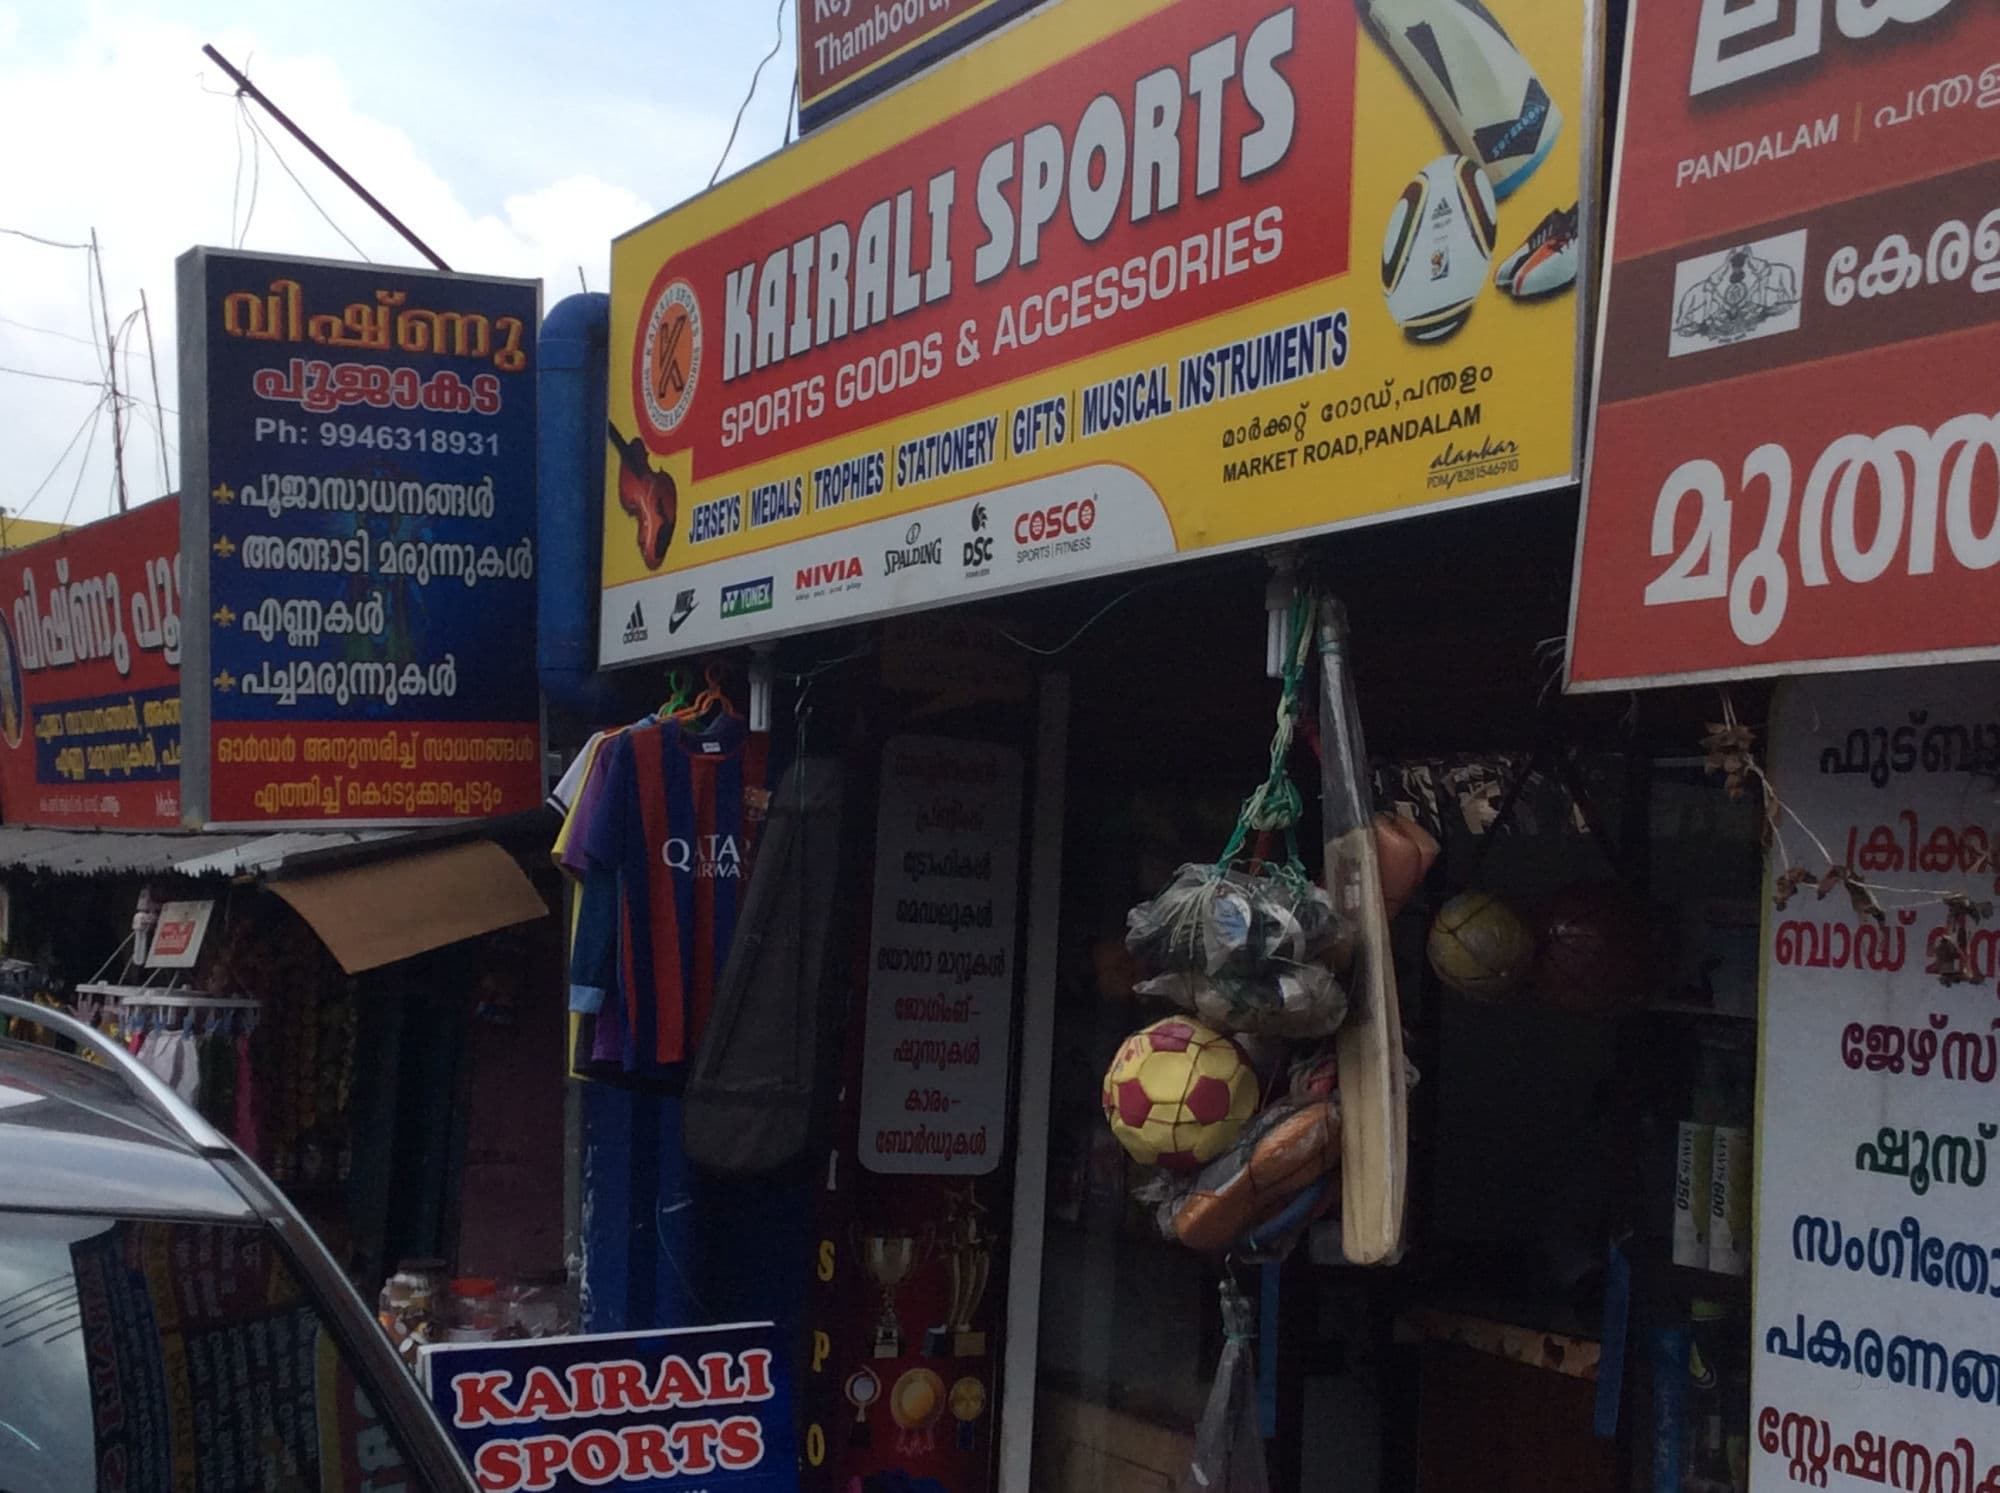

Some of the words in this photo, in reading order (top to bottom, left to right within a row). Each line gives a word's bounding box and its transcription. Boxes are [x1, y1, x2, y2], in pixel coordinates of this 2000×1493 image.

[1675, 113, 1839, 189] PANDALAM
[722, 167, 956, 383] KAIRALI
[975, 6, 1296, 285] SPORTS
[720, 374, 826, 449] SPORTS
[834, 331, 944, 409] GOODS
[956, 318, 981, 368] &
[992, 205, 1284, 357] ACCESSORIES
[253, 357, 501, 414] പൂജാകട
[254, 417, 308, 446] Ph:
[320, 421, 500, 457] 9946318931
[688, 494, 743, 545] JERSEYS
[750, 475, 803, 528] MEDALS
[813, 450, 885, 510] TROPHIES
[896, 415, 999, 488] STATIONERY
[1012, 397, 1067, 456] GIFTS
[1081, 366, 1173, 437] MUSICAL
[1178, 310, 1349, 410] INSTRUMENTS
[1222, 448, 1299, 484] MARKET
[1429, 435, 1520, 471] alankar
[1013, 498, 1096, 545] COSCO
[241, 528, 371, 575] അങ്ങാടി
[378, 537, 534, 588] മരുന്നുകൾ
[795, 556, 864, 591] NIVIA
[883, 537, 943, 578] SPALDING
[962, 535, 995, 568] DSC
[241, 591, 386, 648] എണ്ണകൾ
[673, 588, 697, 615] NIKE
[739, 583, 772, 611] YONEX
[622, 626, 649, 645] adidas
[241, 653, 458, 707] പച്ചമരുന്നുകൾ
[452, 1348, 775, 1430] KAIRALI
[475, 1415, 765, 1493] SPORTS
